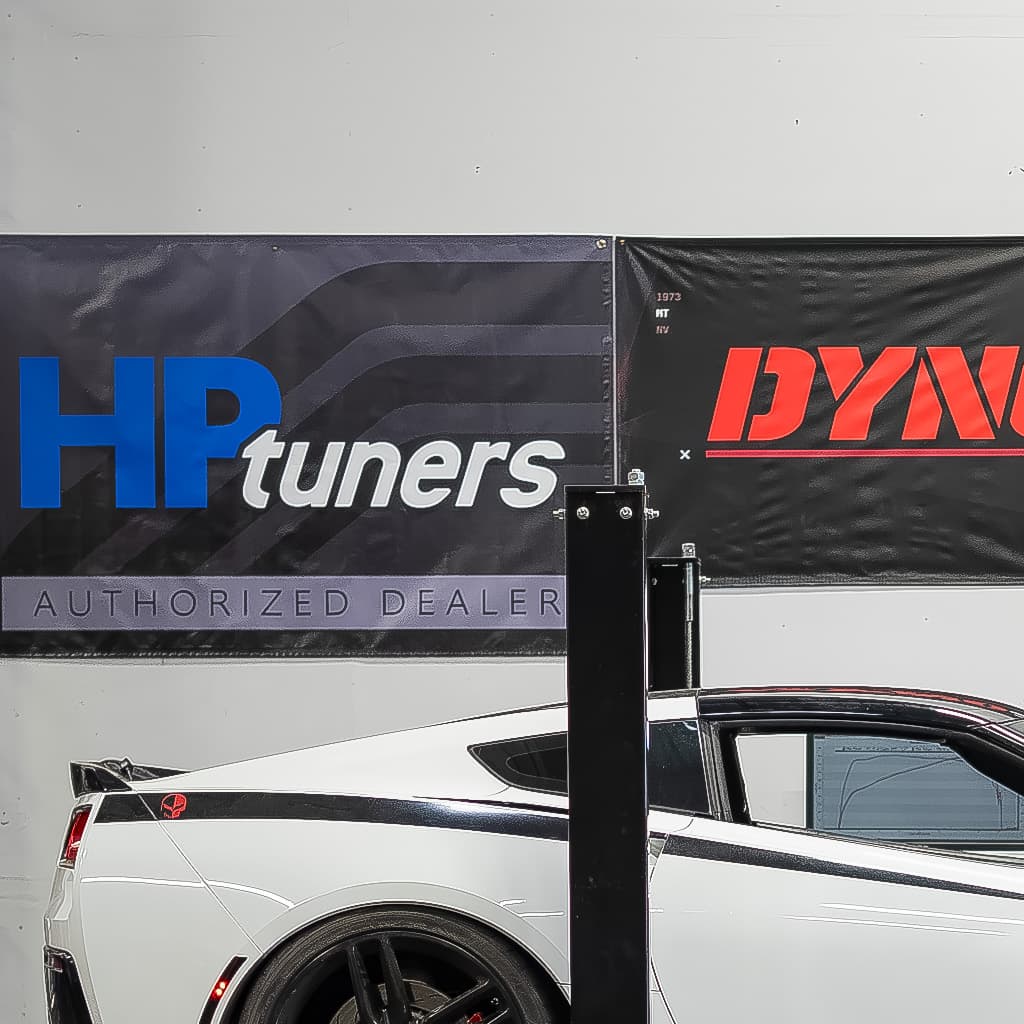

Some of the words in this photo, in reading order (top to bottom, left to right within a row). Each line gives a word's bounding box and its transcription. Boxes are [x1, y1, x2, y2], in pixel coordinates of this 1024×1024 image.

[657, 292, 682, 302] 1973
[19, 356, 282, 509] HP
[241, 429, 567, 509] tuners
[33, 588, 350, 618] AUTHORIZED
[381, 588, 562, 617] DEALER
